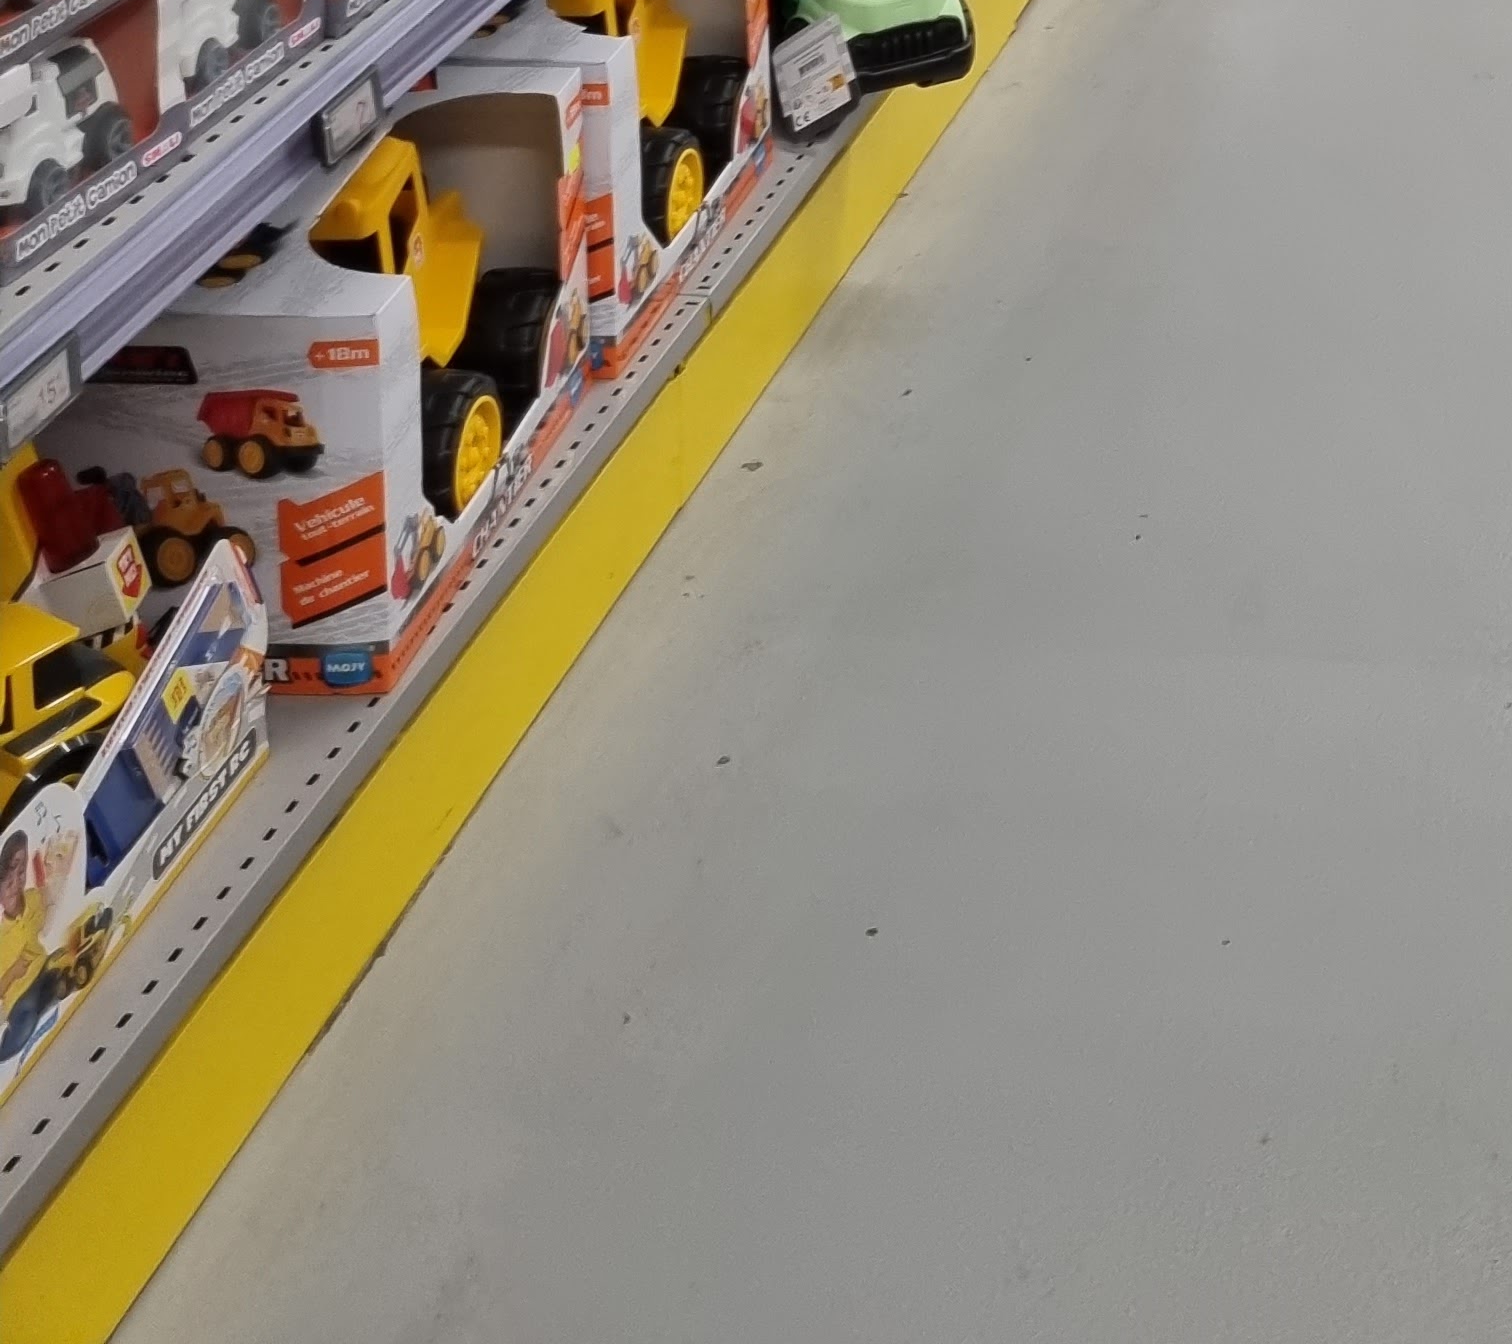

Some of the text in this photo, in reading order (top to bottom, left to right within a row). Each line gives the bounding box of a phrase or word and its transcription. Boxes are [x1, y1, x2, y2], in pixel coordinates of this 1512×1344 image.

[15, 161, 138, 262] Mon Petit Camion
[292, 568, 344, 595] Machine
[299, 569, 371, 606] de chantier
[186, 770, 232, 826] FIRST
[228, 741, 252, 776] RC
